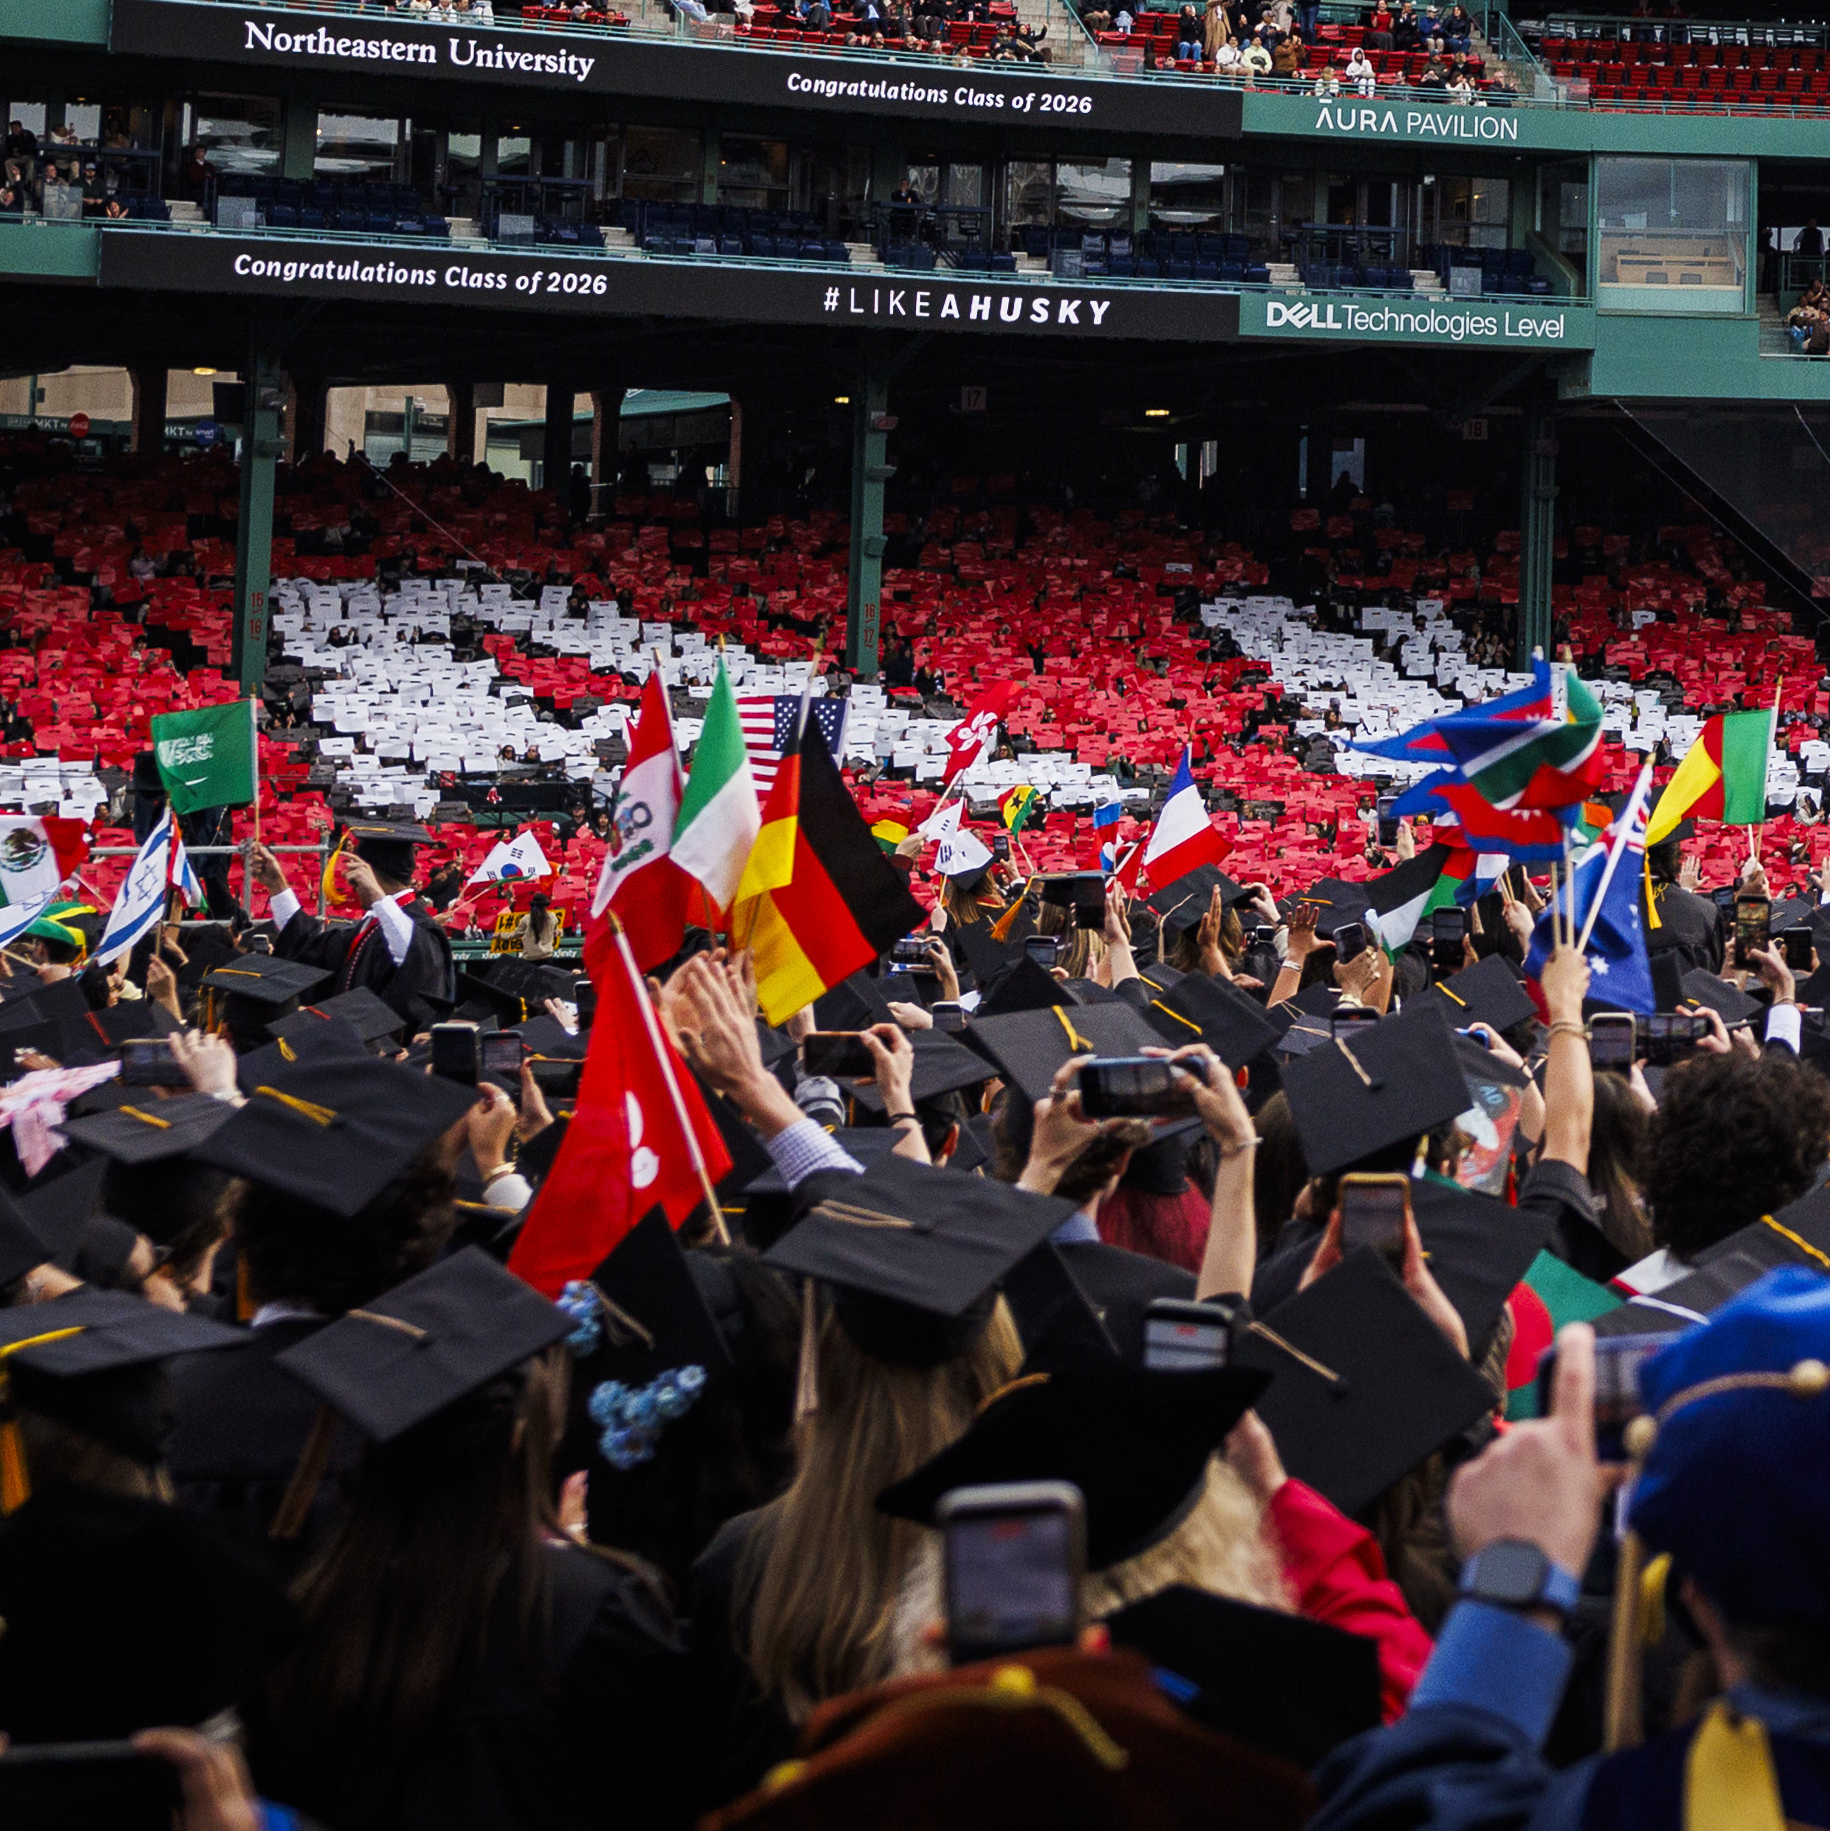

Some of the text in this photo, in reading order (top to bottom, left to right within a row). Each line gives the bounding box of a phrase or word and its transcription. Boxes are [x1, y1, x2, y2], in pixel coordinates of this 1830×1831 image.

[244, 20, 595, 82] Northeastern University
[787, 72, 1093, 114] Congratulations Class of 2026
[1406, 110, 1518, 140] PAVILION
[234, 252, 608, 295] Congratulations Class of 2026
[1342, 304, 1498, 341] Technologies
[1504, 311, 1565, 339] Level
[967, 389, 982, 408] 17
[34, 418, 59, 430] MKT
[1468, 420, 1482, 438] 18
[251, 591, 263, 608] 15
[863, 603, 876, 619] 16
[249, 618, 262, 635] 16
[863, 628, 876, 644] 17
[553, 948, 578, 959] xfinity
